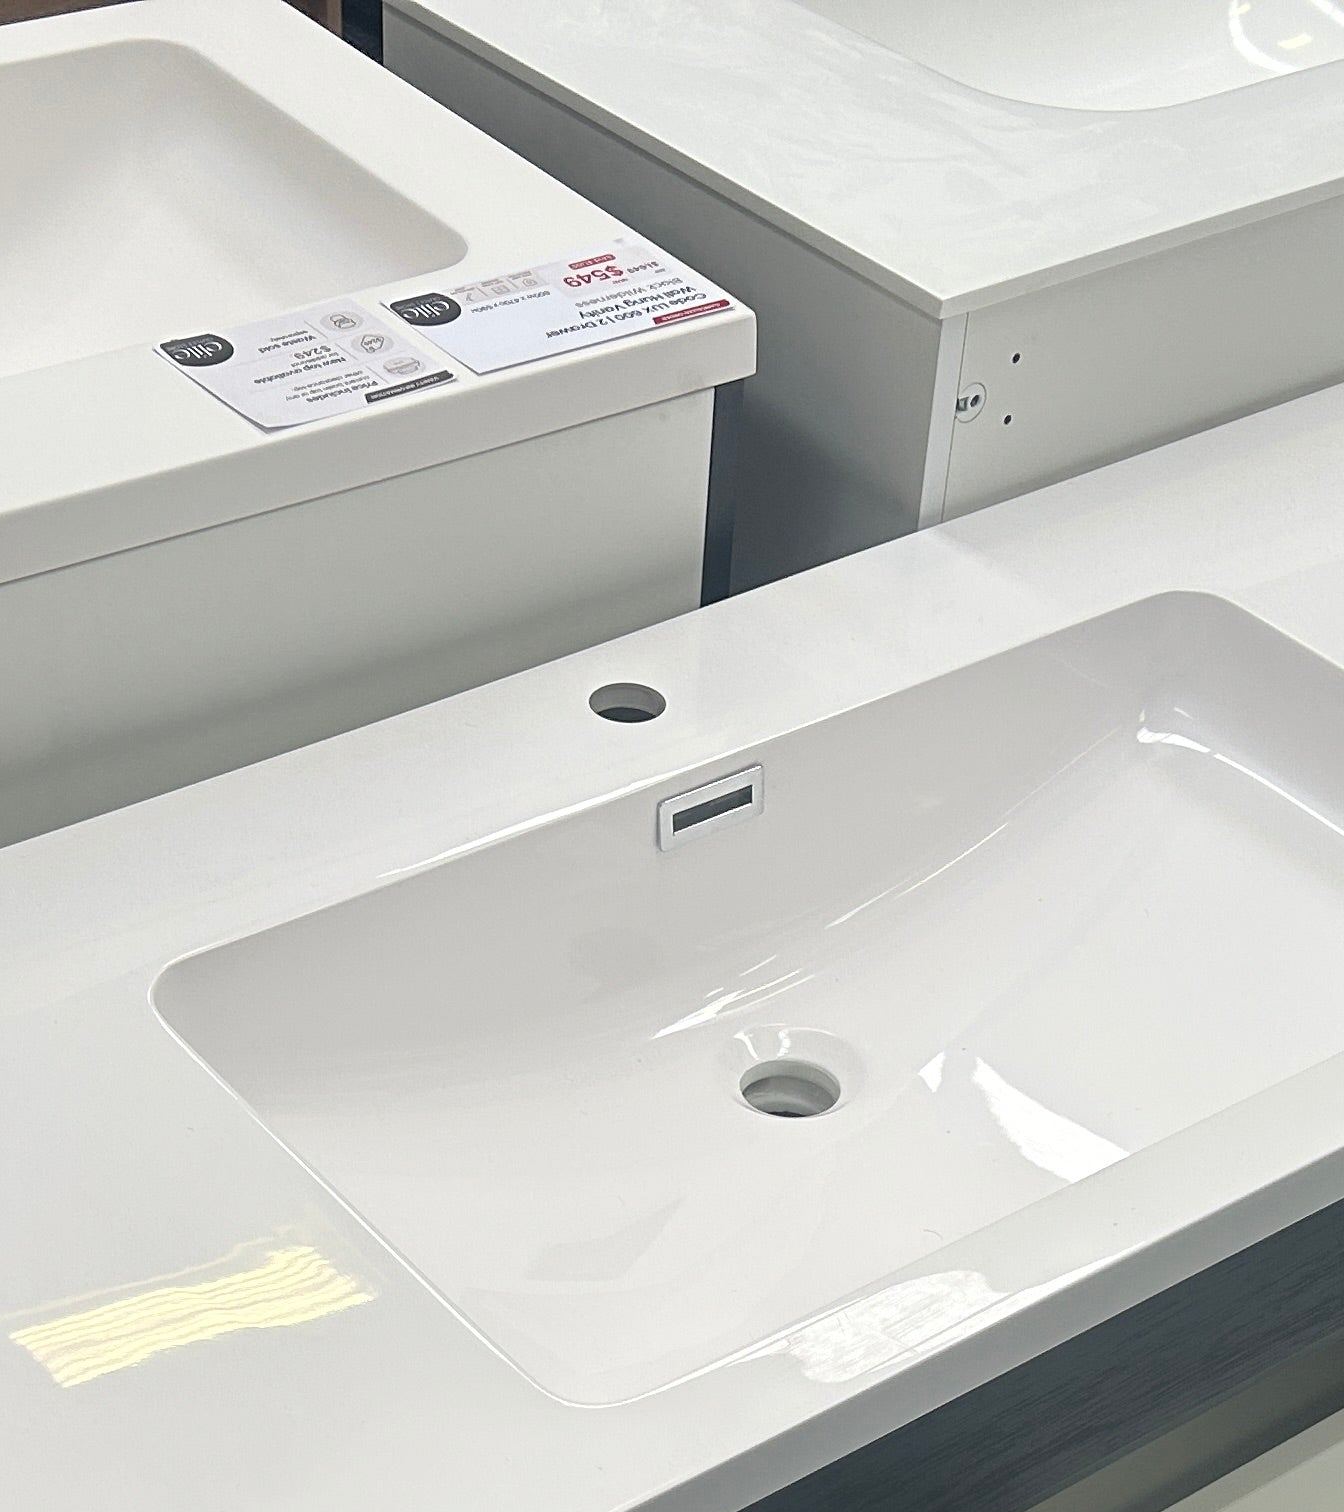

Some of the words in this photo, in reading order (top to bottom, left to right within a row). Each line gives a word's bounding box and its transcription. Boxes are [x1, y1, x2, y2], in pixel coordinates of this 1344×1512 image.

[560, 264, 625, 288] $549
[661, 285, 697, 298] Wall
[621, 292, 665, 307] Hung
[667, 292, 708, 306] Code
[576, 302, 627, 320] Vanity
[640, 301, 671, 314] LUX
[612, 309, 644, 321] 600
[543, 320, 598, 339] Drawer
